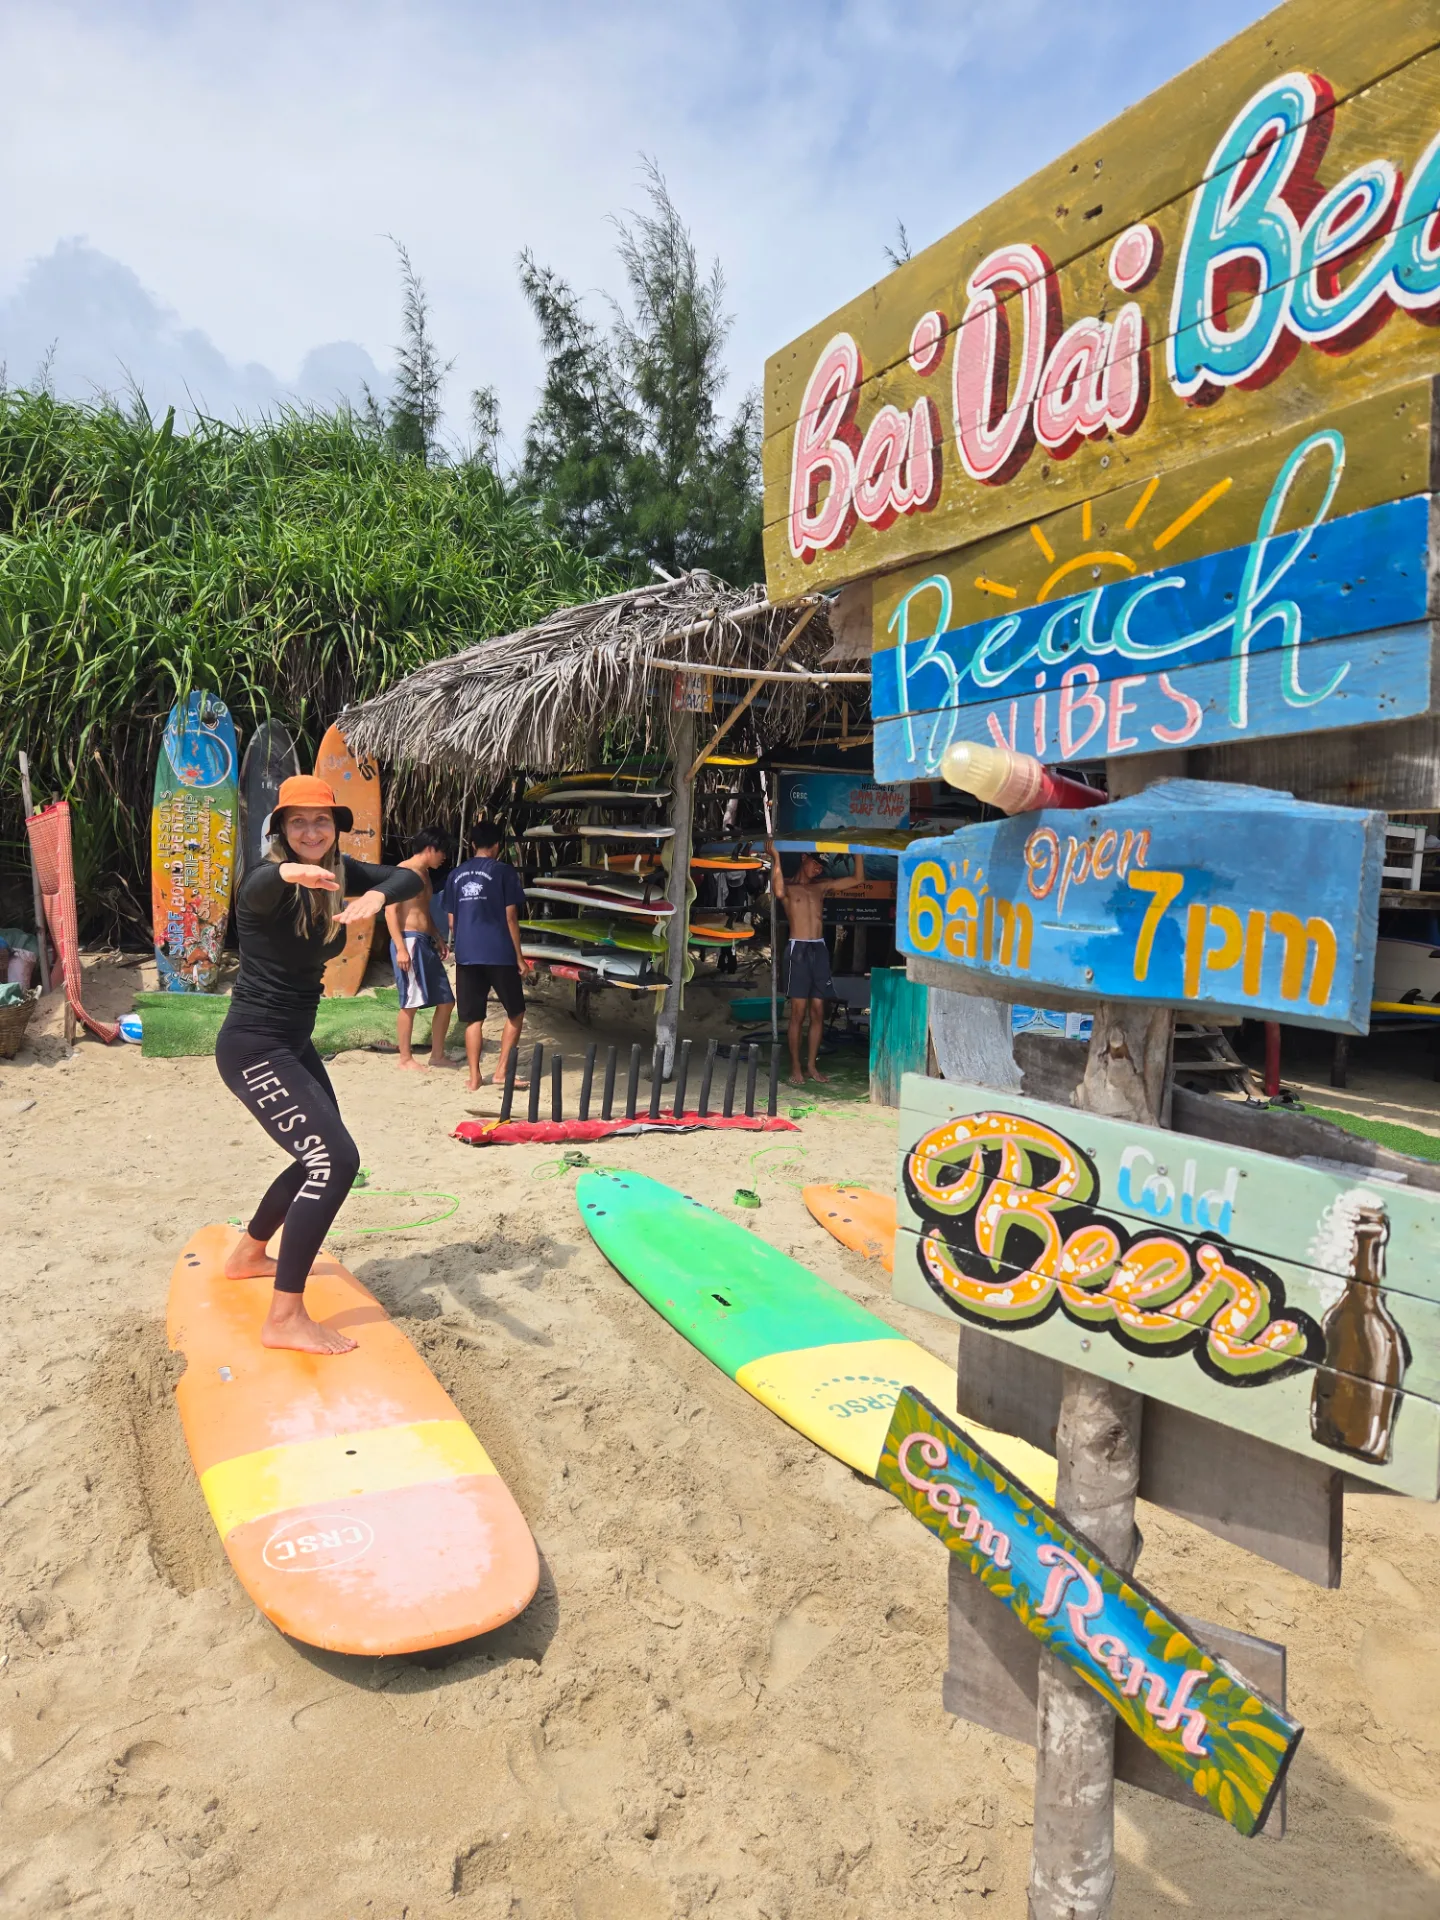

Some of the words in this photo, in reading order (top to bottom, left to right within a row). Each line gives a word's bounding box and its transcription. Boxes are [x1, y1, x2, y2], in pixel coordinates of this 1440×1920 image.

[790, 311, 948, 563] Bai
[952, 223, 1164, 486] Dai
[887, 429, 1350, 774] Beach
[792, 791, 808, 800] CRSC
[849, 789, 873, 802] CAM
[875, 791, 905, 804] RANH
[861, 783, 887, 791] WELCOME
[171, 795, 185, 853] RENTAL
[184, 793, 199, 834] CAMP
[216, 808, 233, 845] Drink
[849, 802, 874, 816] SURF
[877, 804, 905, 817] CAMP
[184, 853, 200, 887] TRIP
[213, 863, 229, 897] Food
[1024, 827, 1151, 919] Open
[168, 910, 186, 956] SURF
[909, 861, 1034, 970] 6am
[1128, 870, 1338, 1006] 7pm
[242, 1061, 289, 1109] LIFE
[270, 1105, 307, 1132] IS
[293, 1134, 331, 1203] SWELL
[1117, 1144, 1241, 1236] Cold
[904, 1110, 1319, 1380] Beer
[828, 1393, 898, 1418] CRSC
[273, 1525, 365, 1561] CRSC
[898, 1431, 1013, 1570] Cam
[1036, 1543, 1210, 1758] Ranh
